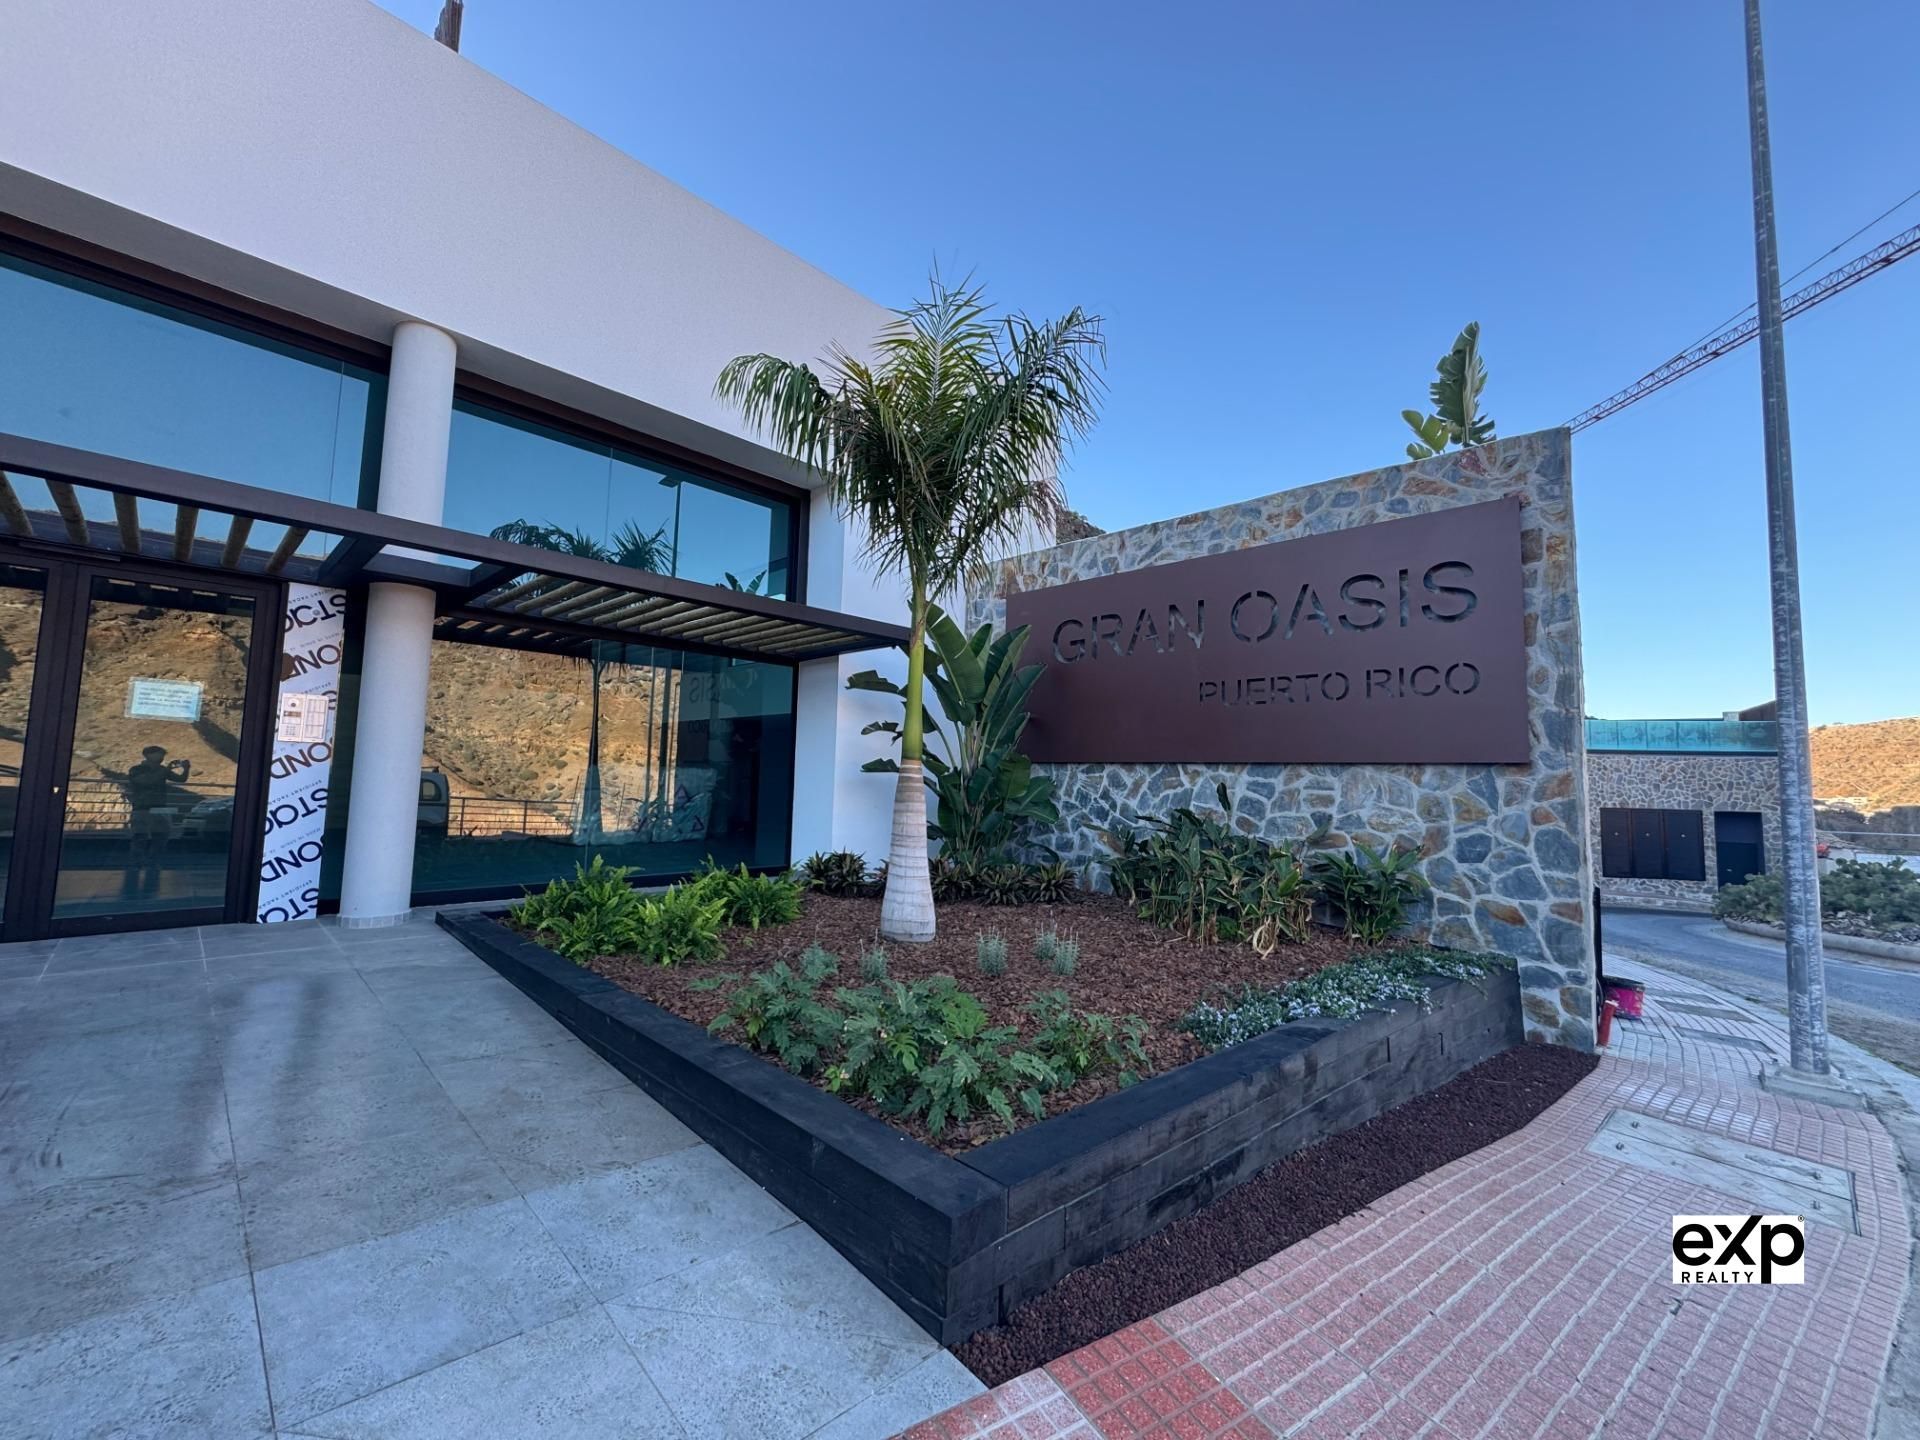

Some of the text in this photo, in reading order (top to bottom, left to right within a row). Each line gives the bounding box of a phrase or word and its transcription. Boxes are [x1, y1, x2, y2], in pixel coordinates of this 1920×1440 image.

[1053, 561, 1478, 664] GRAN OASIS
[1200, 662, 1481, 706] PUERTO RICO
